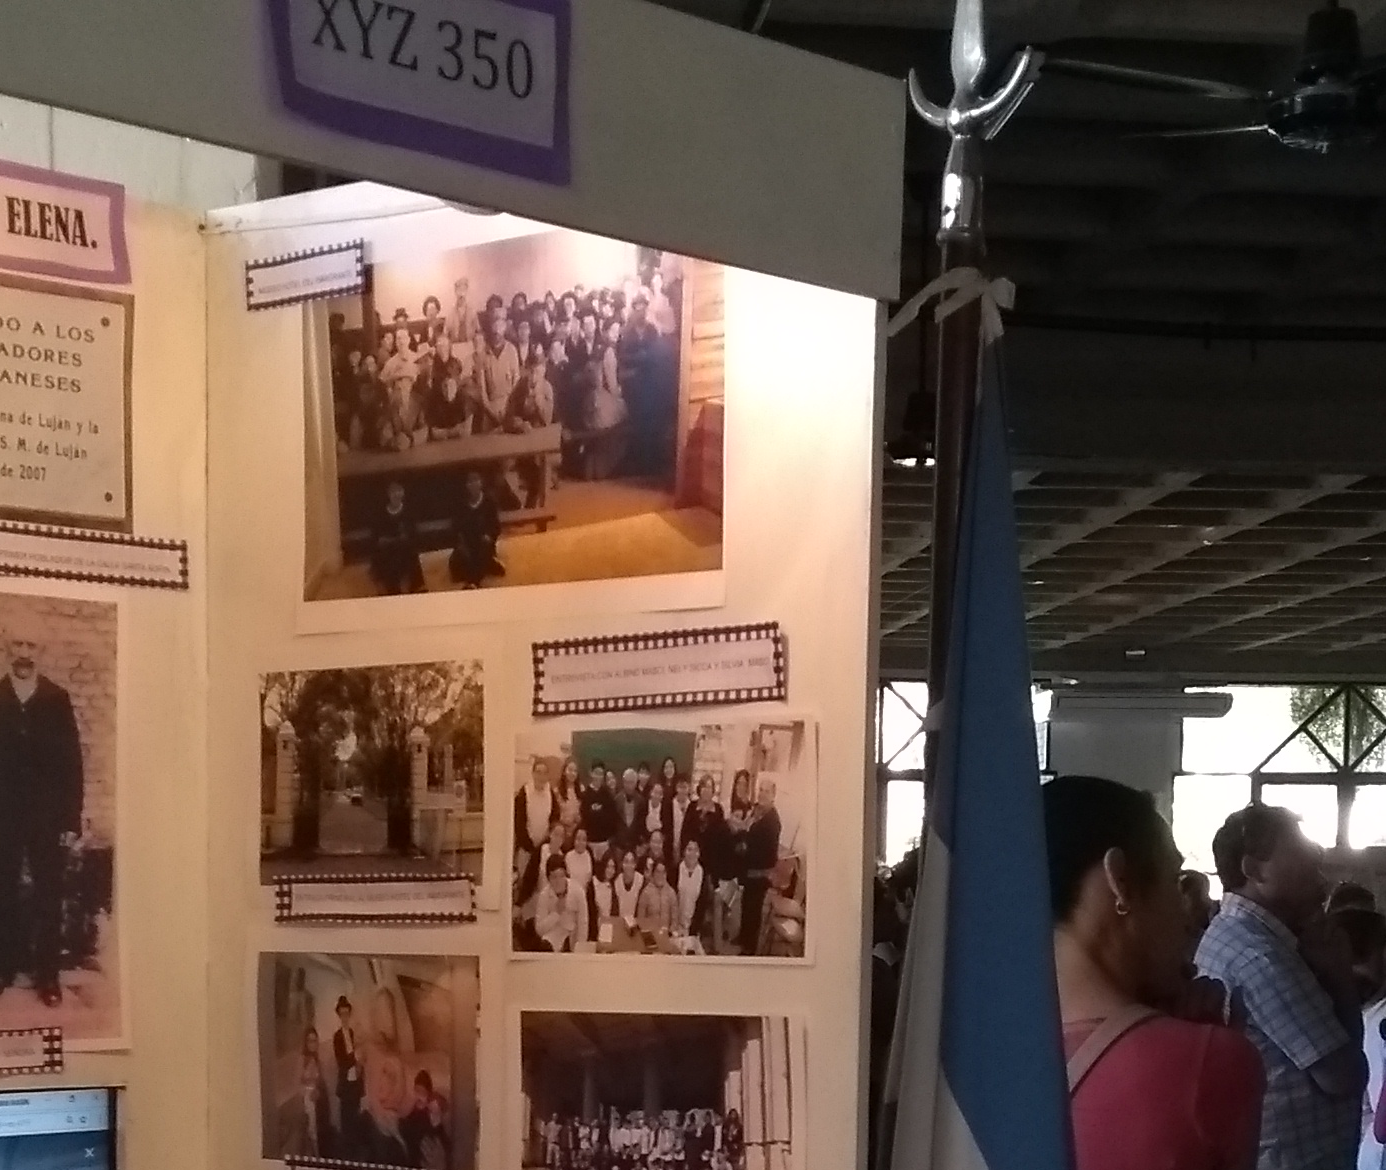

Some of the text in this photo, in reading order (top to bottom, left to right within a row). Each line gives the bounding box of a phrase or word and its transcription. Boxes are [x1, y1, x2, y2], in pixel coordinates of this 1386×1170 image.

[312, 0, 534, 99] XYZ 350
[5, 195, 99, 249] ELENA.
[31, 320, 46, 337] A
[55, 324, 96, 345] LOS
[18, 411, 34, 427] de
[75, 421, 84, 437] y
[87, 419, 100, 435] la
[36, 440, 51, 456] de
[0, 462, 14, 480] de
[18, 463, 47, 482] 2007
